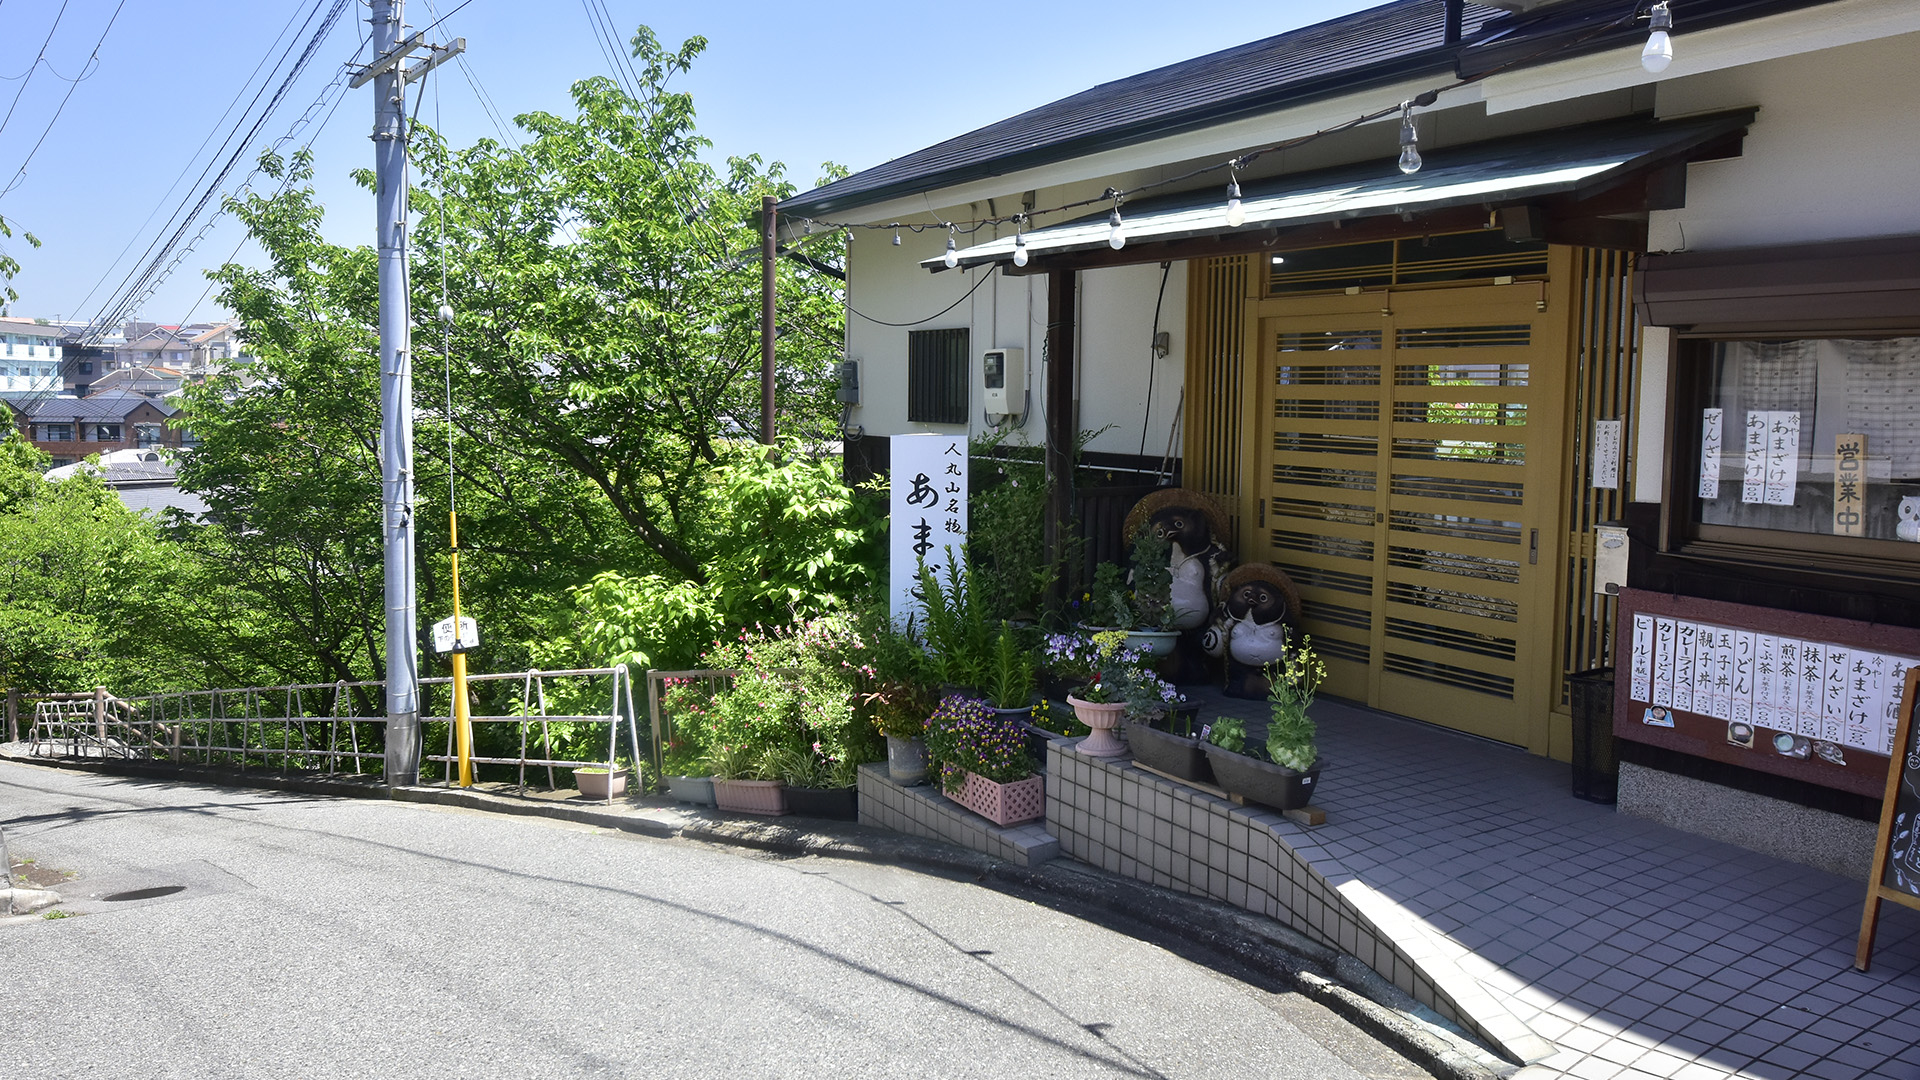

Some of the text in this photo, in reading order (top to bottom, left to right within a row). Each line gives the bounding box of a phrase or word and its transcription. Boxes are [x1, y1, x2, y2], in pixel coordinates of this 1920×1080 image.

[1703, 412, 1721, 471] ぜんざい
[1744, 414, 1765, 478] あまざけ
[1770, 421, 1789, 482] あまざけ
[1788, 415, 1800, 447] 冷やし
[944, 442, 962, 533] 人丸山名物
[1837, 441, 1860, 533] 営業中
[1633, 617, 1651, 655] ビール
[1656, 622, 1672, 682] カレーうどん
[1677, 626, 1694, 687] カレーライス
[1697, 629, 1714, 690] 親子丼
[1715, 634, 1732, 693] 玉子丼
[1734, 636, 1752, 694] うどん
[1758, 638, 1774, 674] こぶ茶
[1779, 643, 1797, 678] 煎茶
[1802, 646, 1822, 682] 抹茶
[1827, 652, 1846, 714] ぜんざい
[1849, 660, 1871, 724] あまざけ
[1872, 656, 1883, 690] 冷やし
